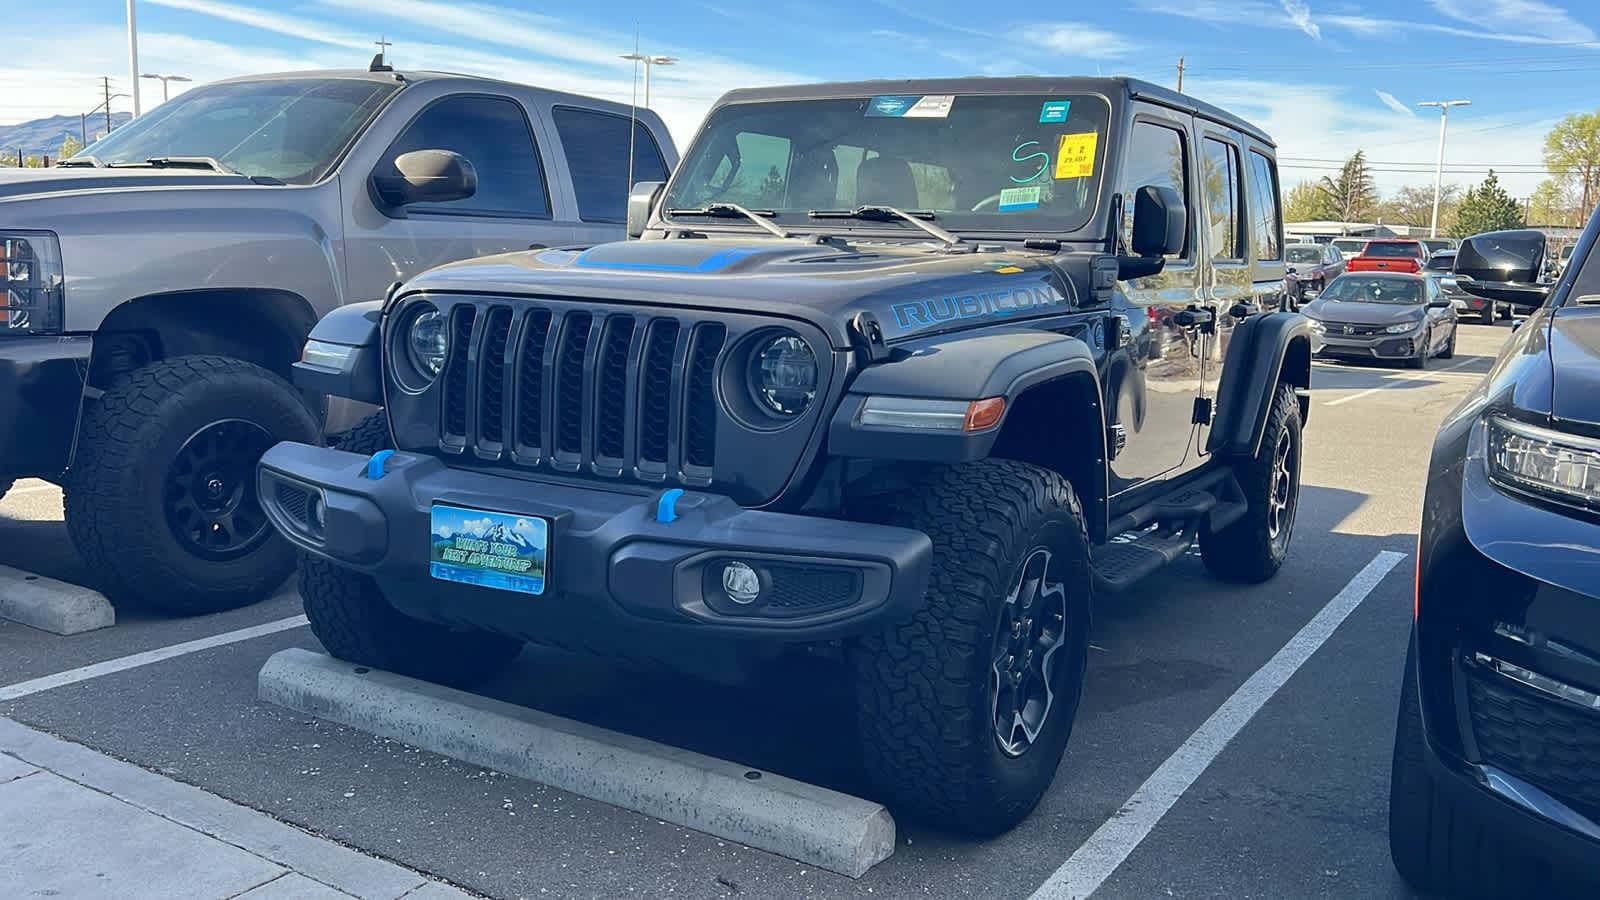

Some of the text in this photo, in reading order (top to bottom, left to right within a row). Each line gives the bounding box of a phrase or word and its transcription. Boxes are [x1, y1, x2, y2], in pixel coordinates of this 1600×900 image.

[1010, 141, 1049, 183] S
[891, 287, 1058, 328] RUBICON
[442, 548, 531, 572] NEXT ADVENTURE?
[456, 537, 517, 557] WHAT'S YOUR
